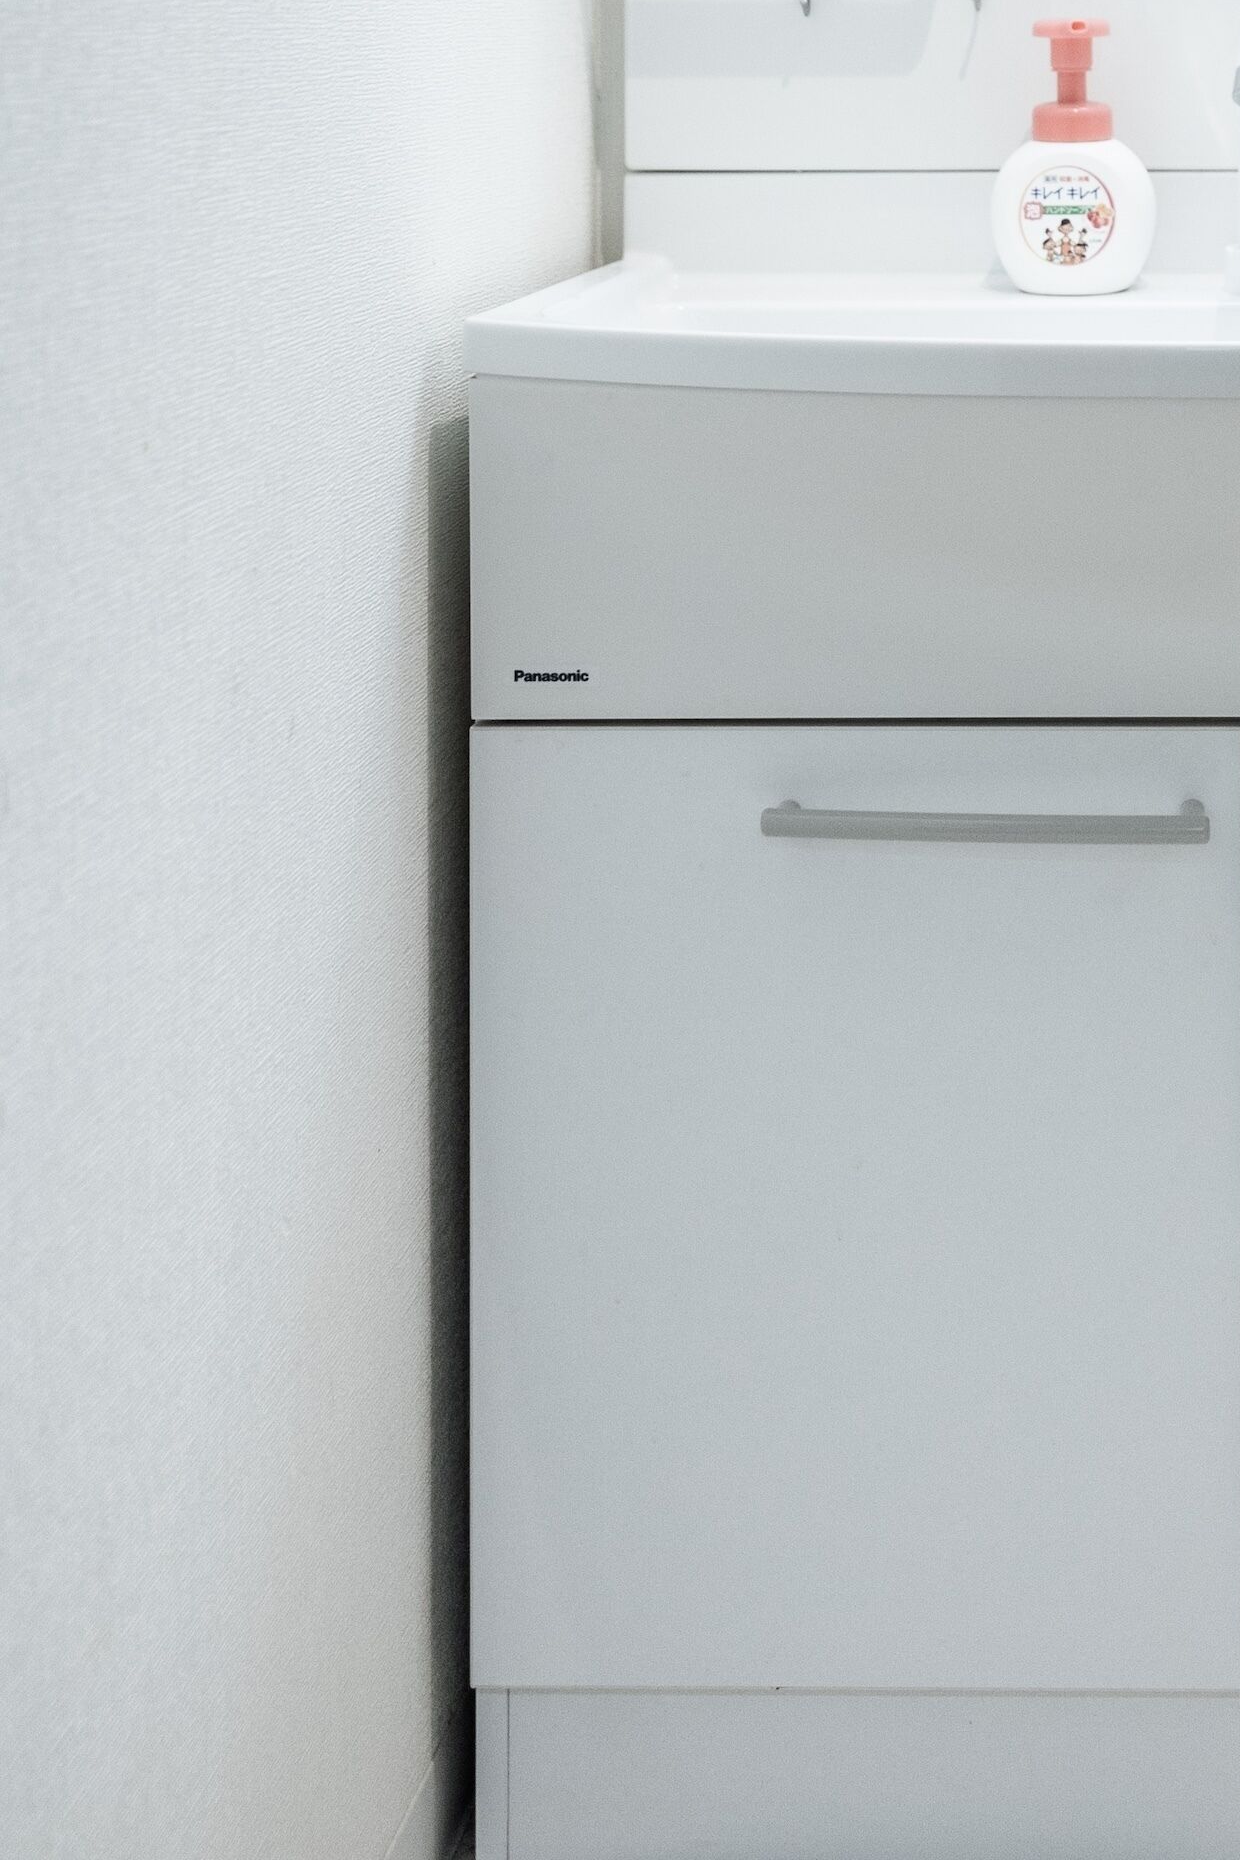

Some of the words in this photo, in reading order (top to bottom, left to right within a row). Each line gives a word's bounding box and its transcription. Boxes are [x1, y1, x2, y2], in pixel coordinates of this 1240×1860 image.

[1031, 186, 1063, 200] キレイ
[1067, 186, 1100, 200] キレイ
[514, 669, 589, 682] Panasonic
